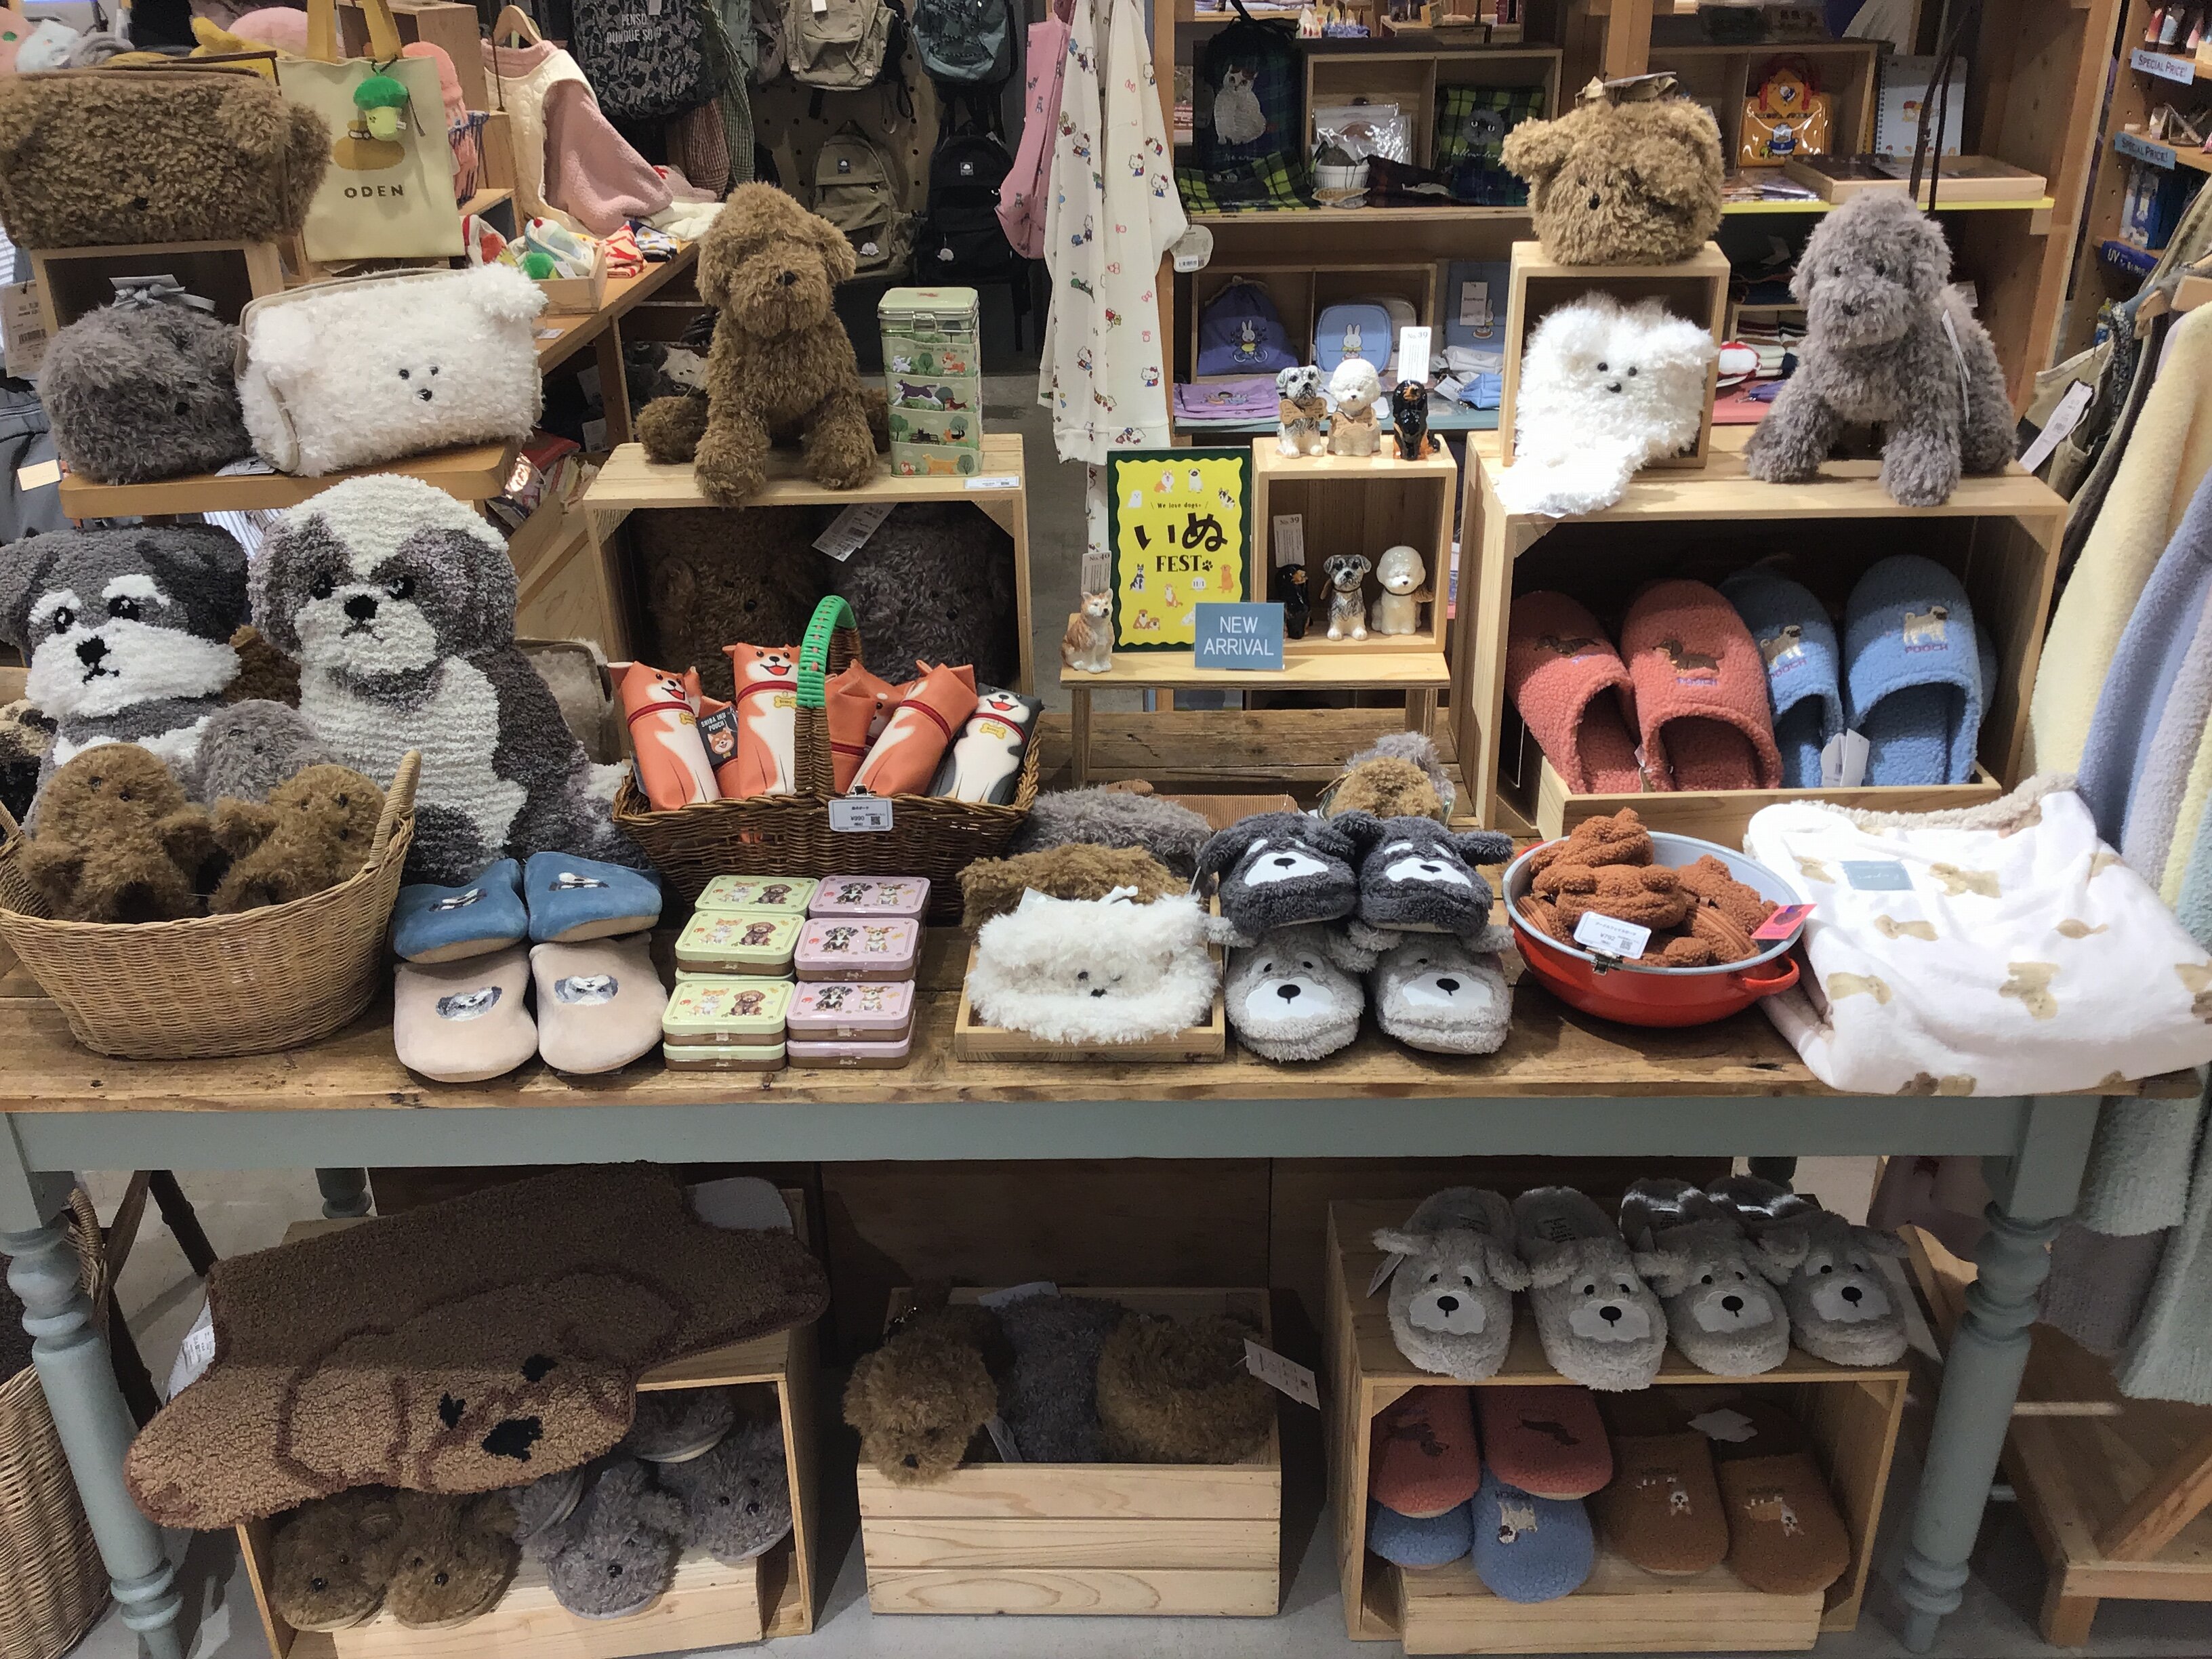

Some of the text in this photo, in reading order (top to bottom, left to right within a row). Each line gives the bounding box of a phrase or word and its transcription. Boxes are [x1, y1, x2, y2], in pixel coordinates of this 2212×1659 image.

[2139, 54, 2188, 77] SPECIAL PRICE!
[2122, 138, 2169, 162] SPECIAL PRICE!
[344, 184, 403, 199] ODEN
[1134, 512, 1228, 552] いぬ
[1156, 554, 1202, 572] FEST
[1220, 616, 1258, 634] NEW
[1204, 637, 1274, 656] ARRIVAL
[1904, 643, 1949, 654] POOCH
[701, 716, 716, 728] SHIBA
[708, 720, 725, 732] POUCH
